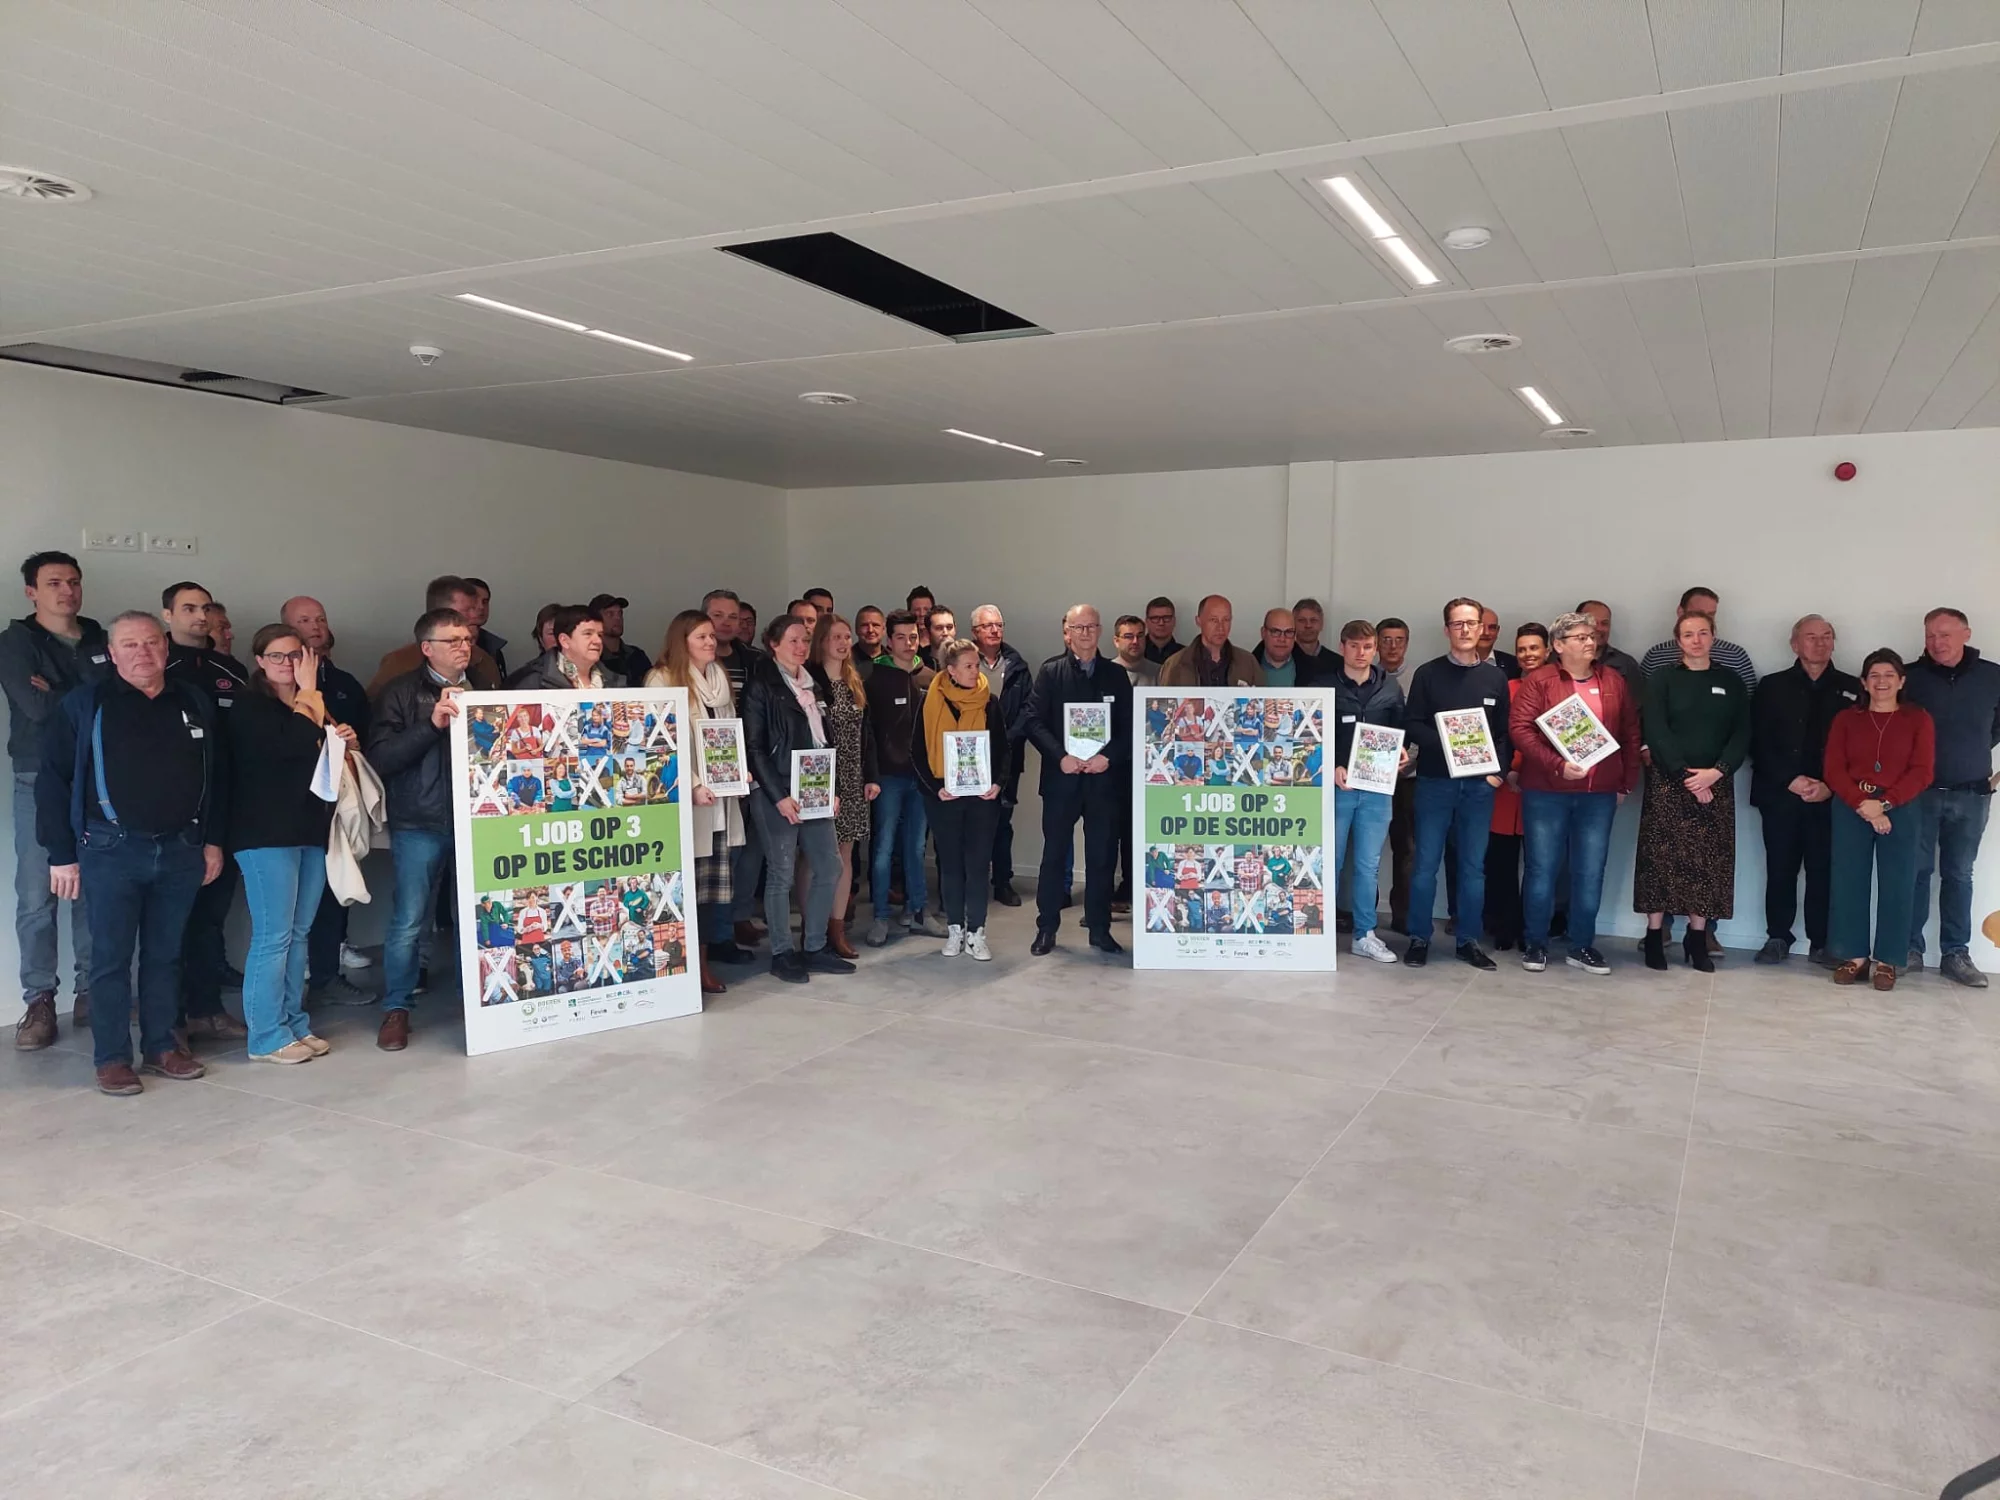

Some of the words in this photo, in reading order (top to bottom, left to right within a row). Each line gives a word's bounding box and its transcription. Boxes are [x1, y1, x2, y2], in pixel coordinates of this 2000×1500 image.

[1182, 793, 1192, 813] 1
[1194, 793, 1236, 813] JOB
[1241, 793, 1269, 813] OP
[1273, 794, 1287, 813] 3
[518, 823, 531, 848] 1
[535, 819, 584, 848] JOB
[590, 816, 621, 841] OP
[626, 815, 641, 838] 3
[1160, 816, 1188, 836] OP
[1193, 817, 1220, 836] DE
[1225, 817, 1307, 837] SCHOP?
[493, 854, 528, 880] OP
[534, 850, 566, 876] DE
[572, 840, 664, 872] SCHOP?
